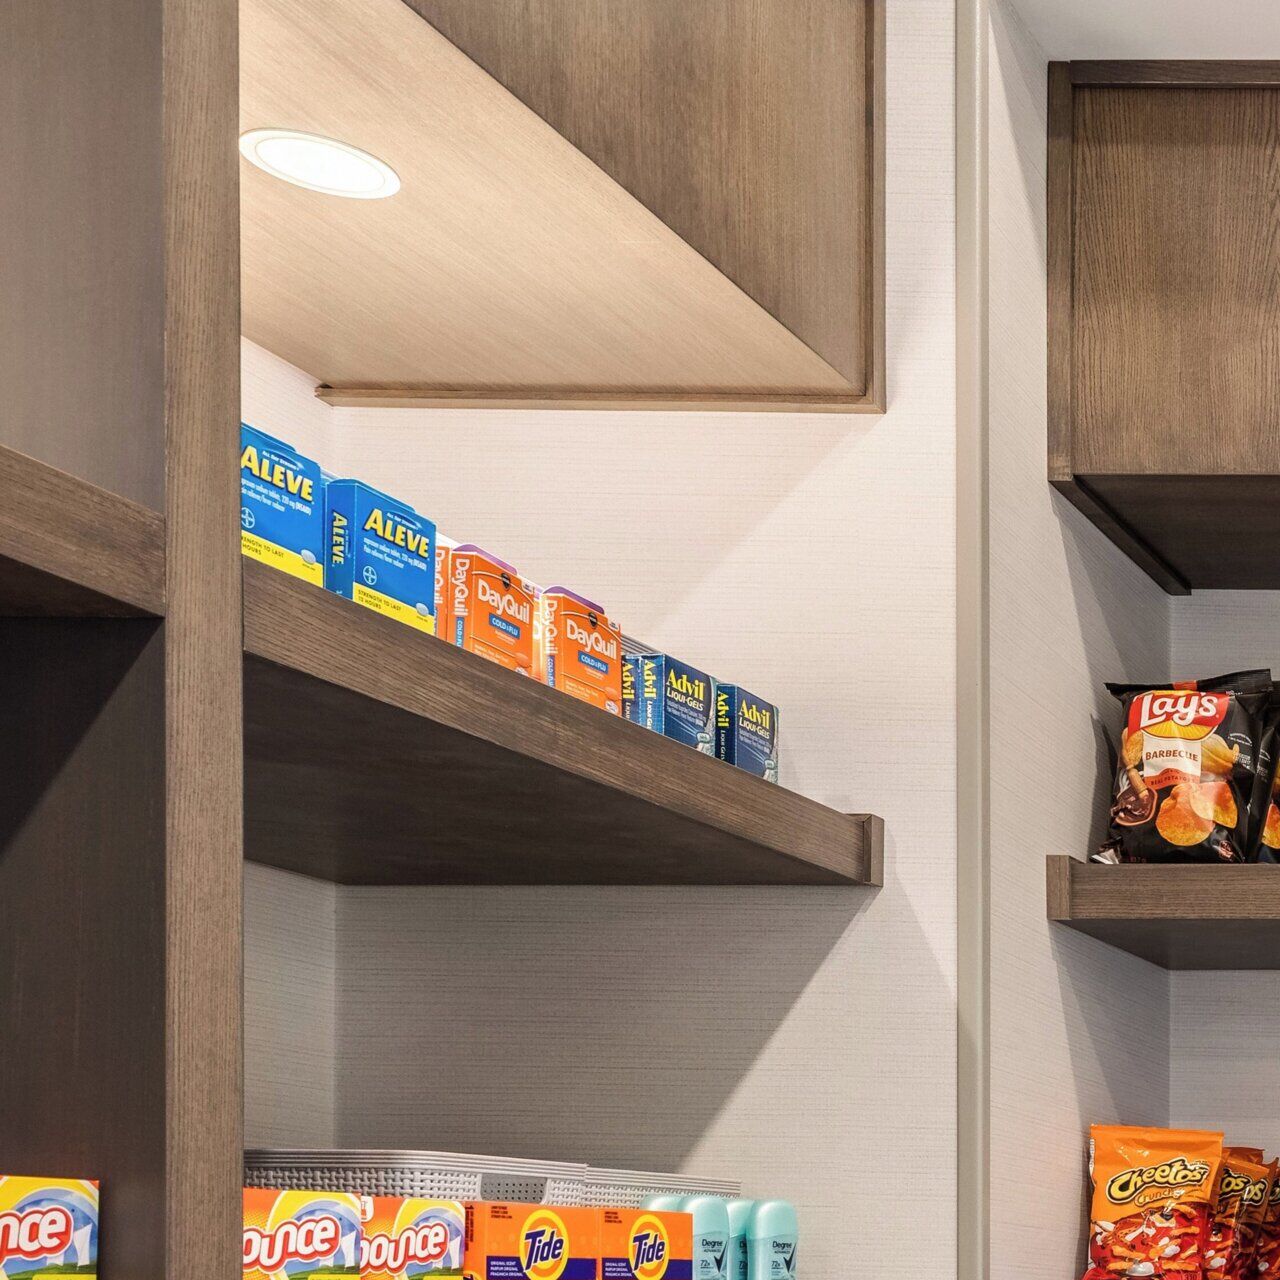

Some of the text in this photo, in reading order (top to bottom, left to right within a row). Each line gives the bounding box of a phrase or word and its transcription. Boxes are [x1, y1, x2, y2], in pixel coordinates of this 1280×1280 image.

[241, 446, 313, 502] ALEVE
[332, 512, 348, 565] ALEVE
[364, 508, 430, 558] ALEVE
[358, 589, 383, 605] STRENGTH
[451, 558, 470, 616] DayQuil
[478, 578, 529, 624] DayQuil
[492, 617, 506, 630] COLD
[541, 599, 558, 655] DayQuil
[567, 619, 617, 660] DayQuil
[581, 654, 595, 666] COLD
[622, 661, 634, 699] Advil
[644, 660, 656, 699] Advil
[666, 669, 704, 700] Advil
[667, 687, 704, 712] LIQUI-GELS
[717, 690, 730, 728] Advil
[738, 699, 770, 729] Advil
[1140, 691, 1218, 728] Lay's
[739, 717, 770, 739] LIQUI-GELS
[1145, 749, 1199, 762] BARBECUE
[1109, 1158, 1210, 1200] Cheetos
[523, 1229, 564, 1271] Tide
[633, 1232, 665, 1273] Tide
[702, 1239, 723, 1249] Degree
[772, 1241, 792, 1249] Degree
